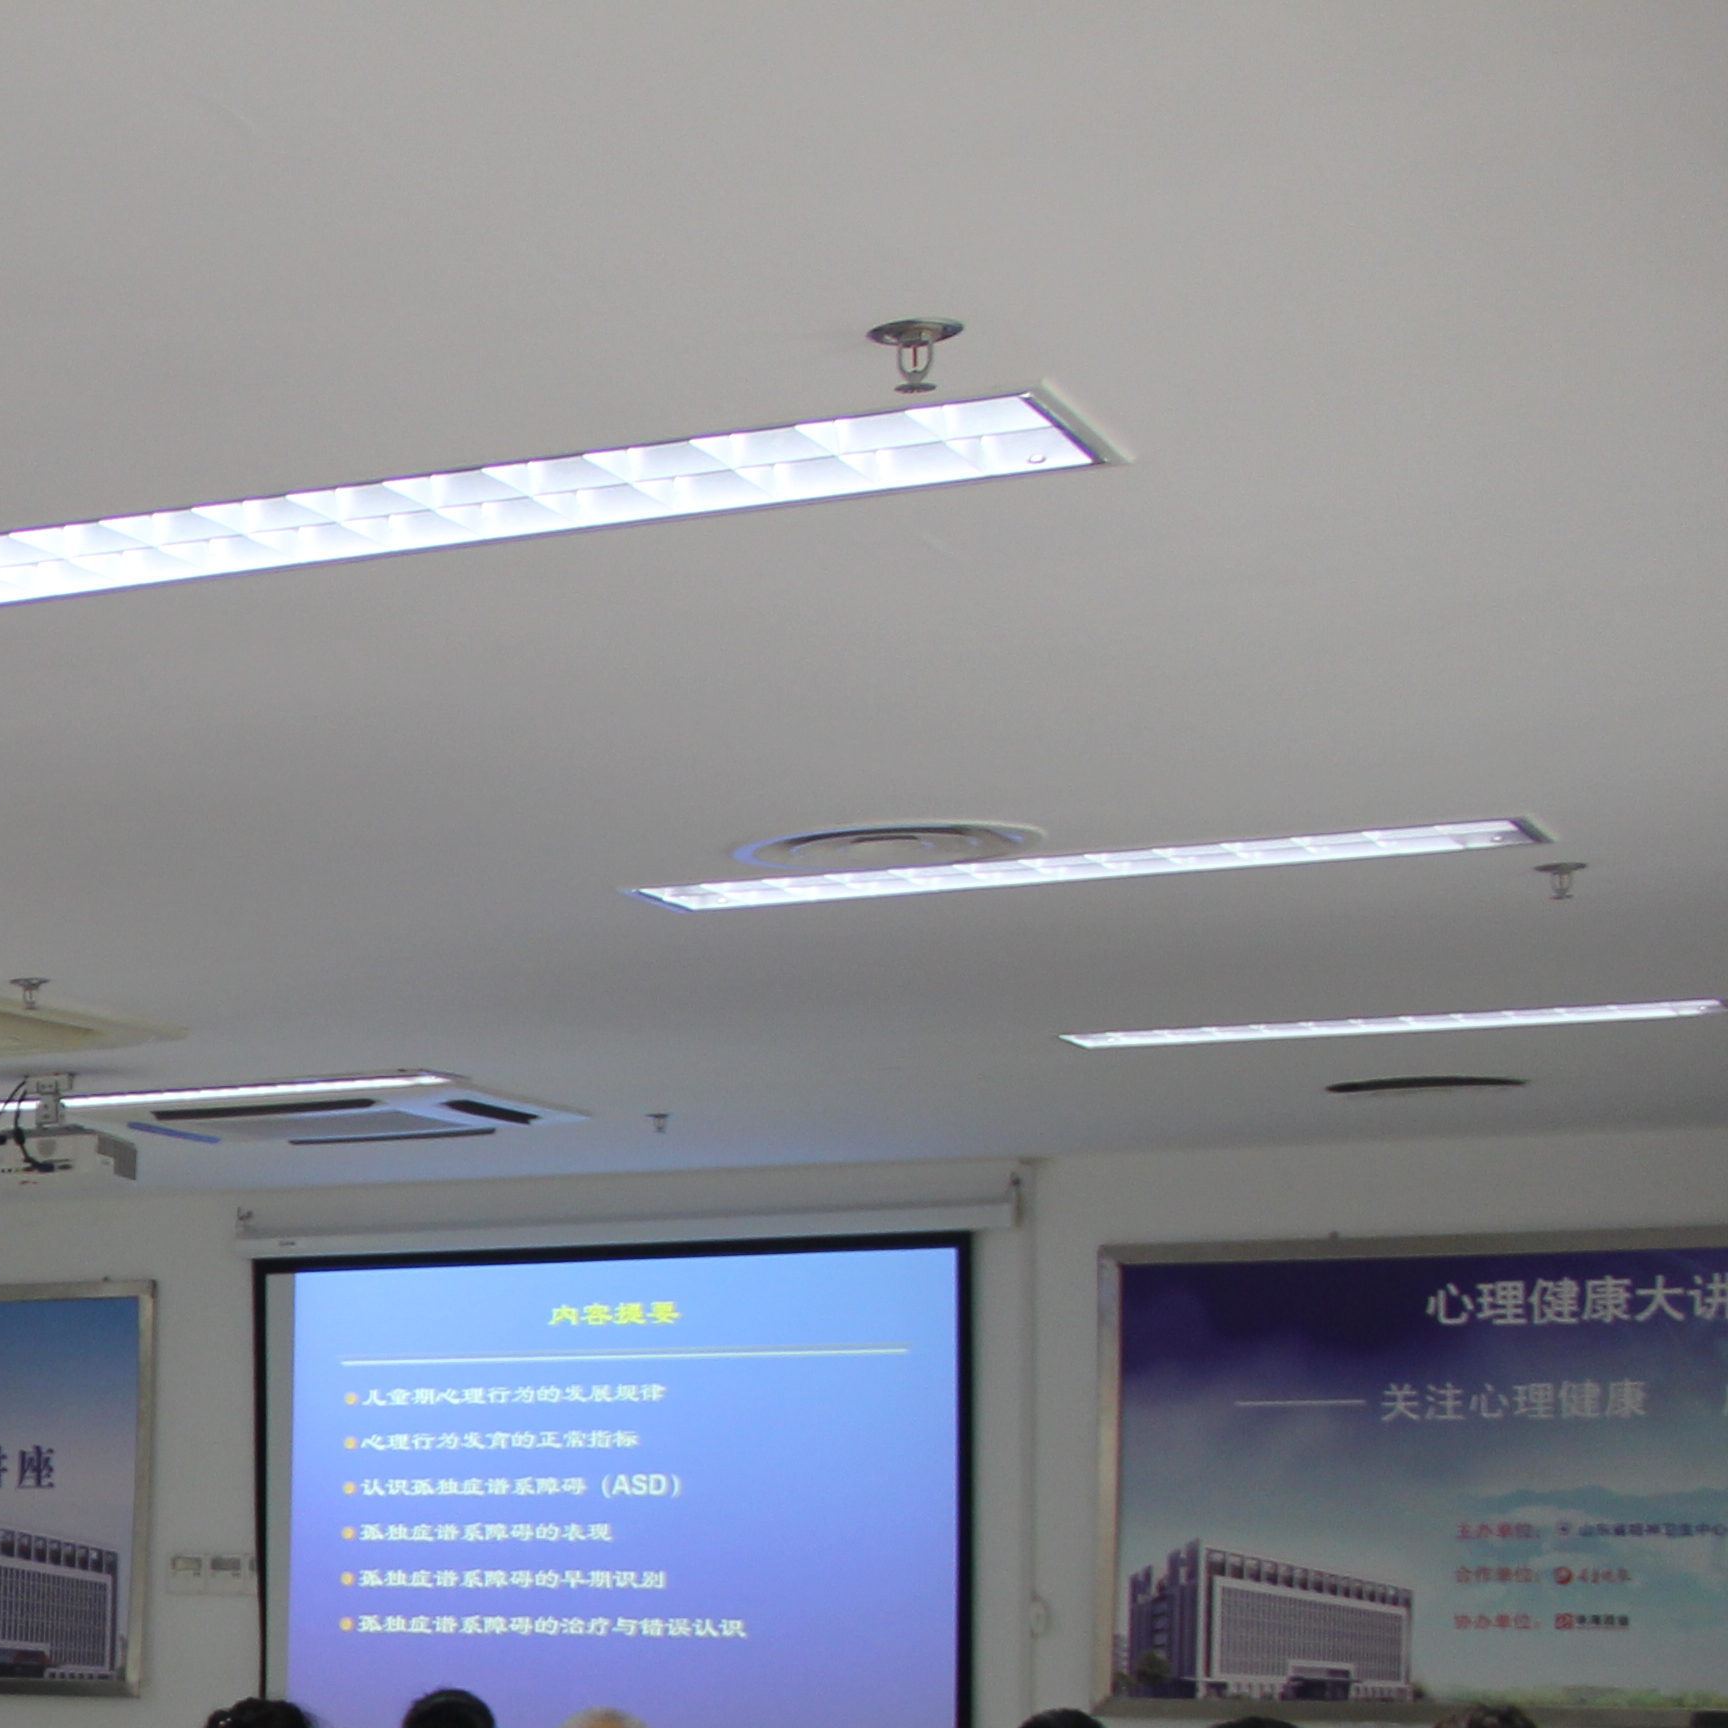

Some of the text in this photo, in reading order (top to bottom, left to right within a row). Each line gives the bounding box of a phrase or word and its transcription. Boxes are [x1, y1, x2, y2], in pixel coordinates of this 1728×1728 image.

[548, 1301, 682, 1326] 内容提要
[1425, 1273, 1728, 1326] 心理健康大讲
[1381, 1379, 1648, 1422] 关注心理健康
